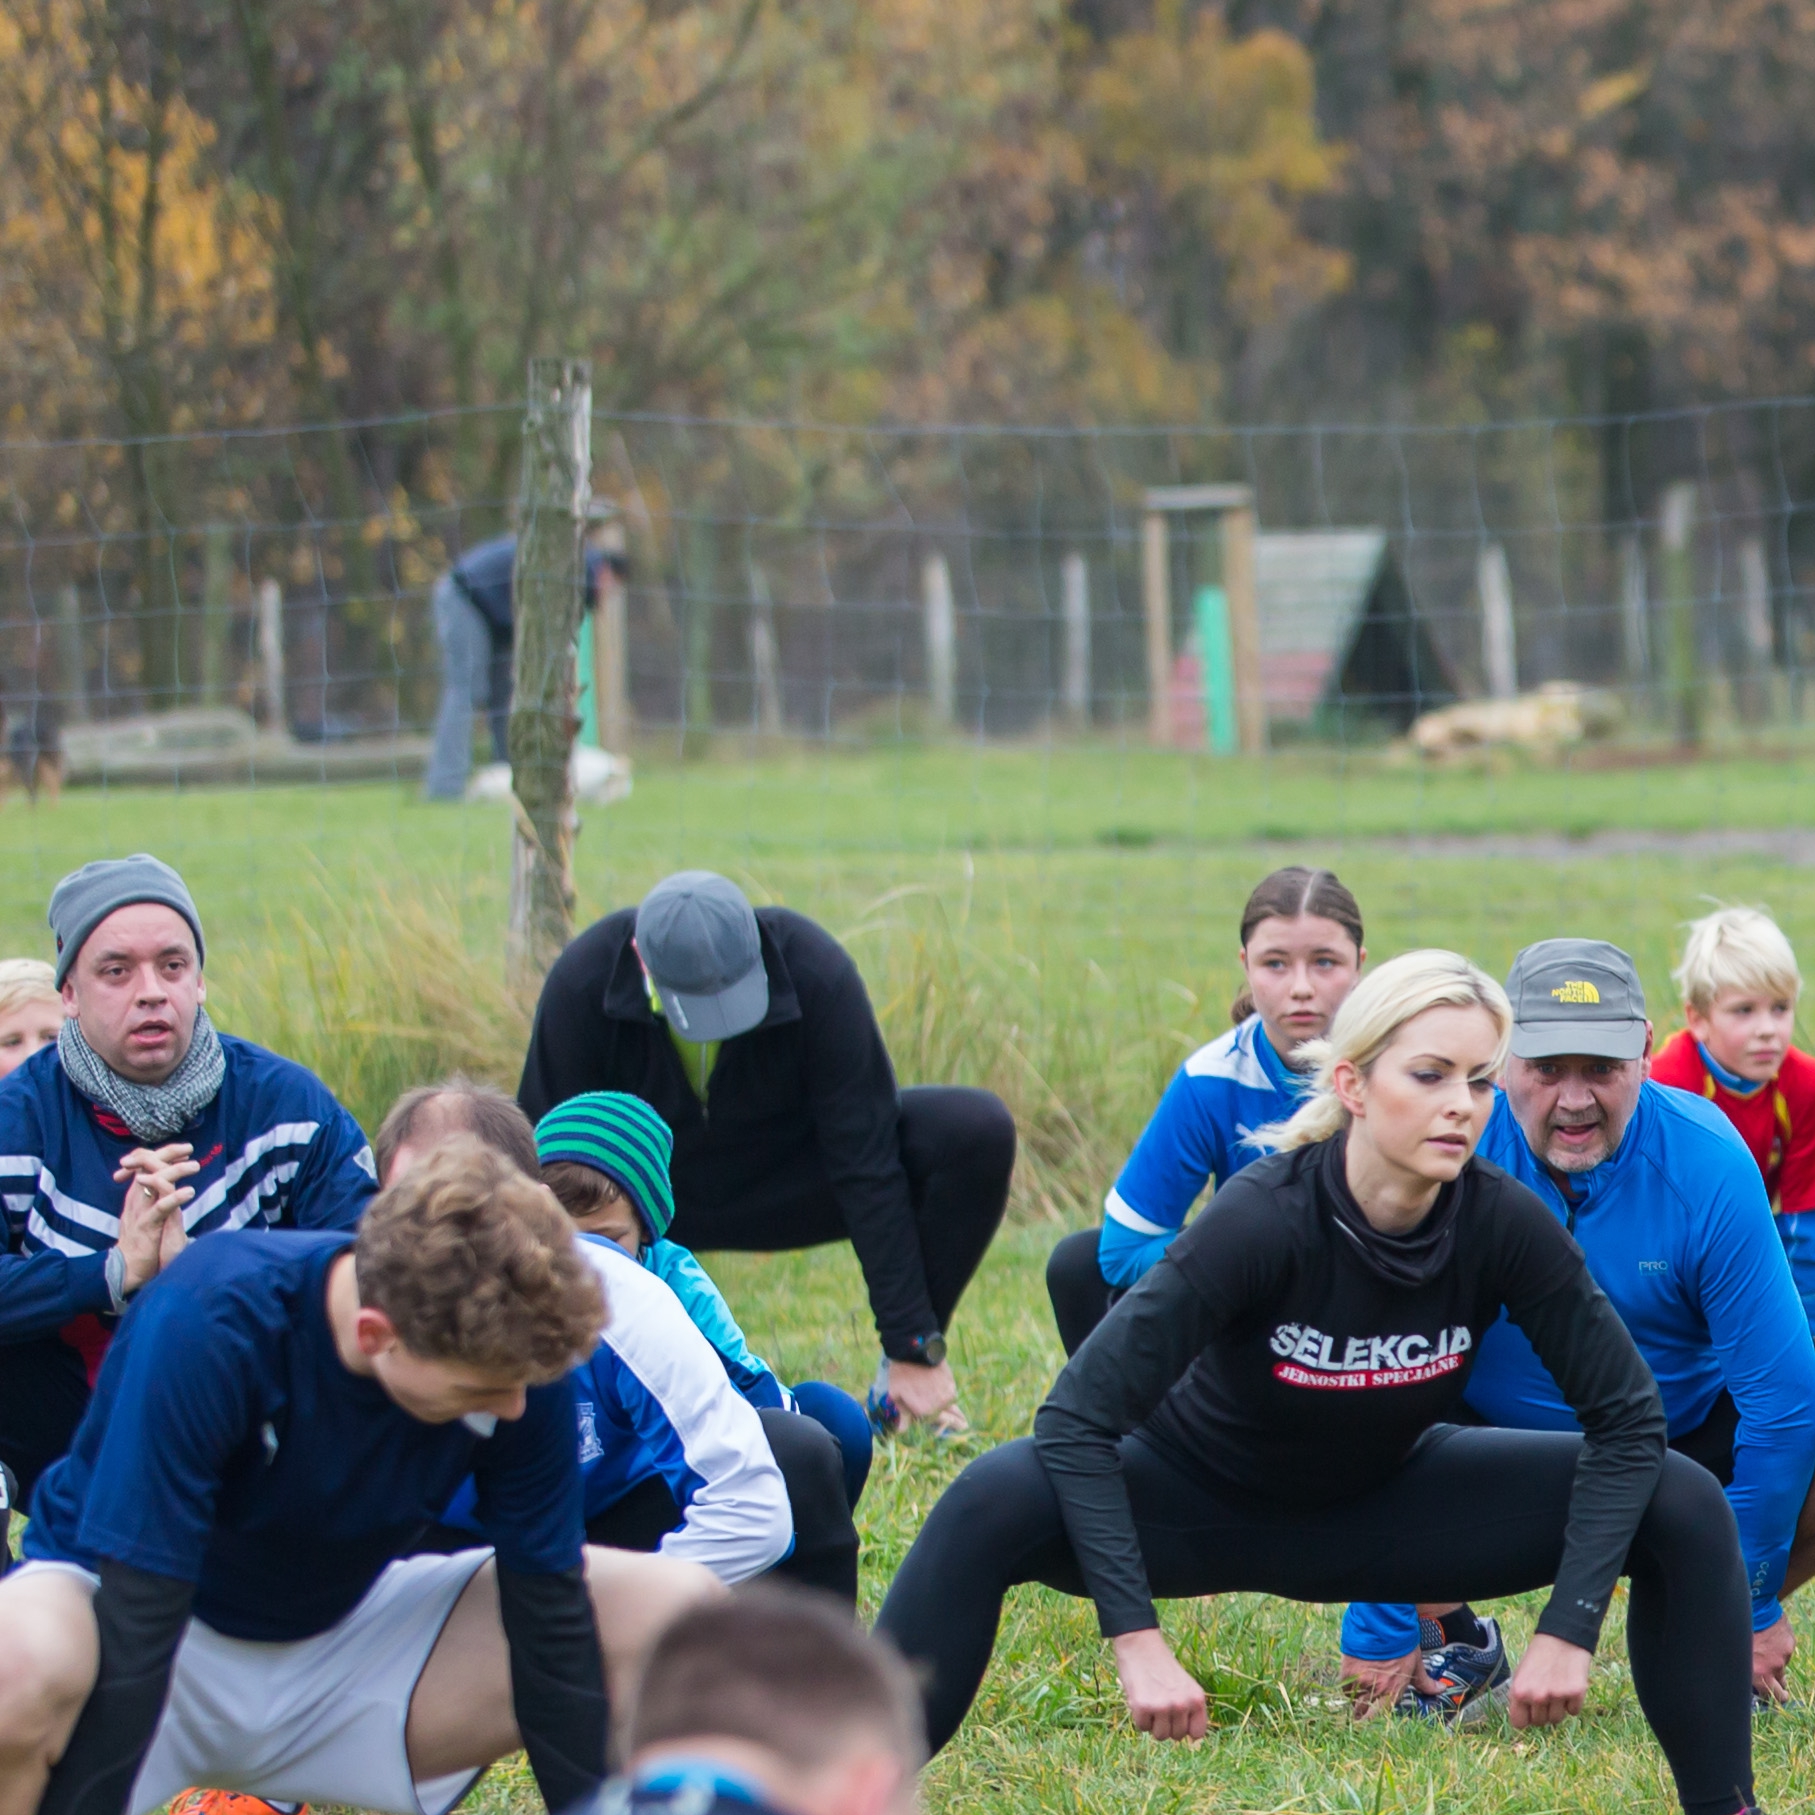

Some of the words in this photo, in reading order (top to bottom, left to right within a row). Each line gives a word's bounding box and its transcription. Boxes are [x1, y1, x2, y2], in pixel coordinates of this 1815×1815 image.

[1638, 1260, 1669, 1273] PRO
[1269, 1321, 1472, 1371] SELEKCJA
[1279, 1366, 1366, 1387] JEDNOSTKI
[1372, 1355, 1459, 1386] SPECJALNE
